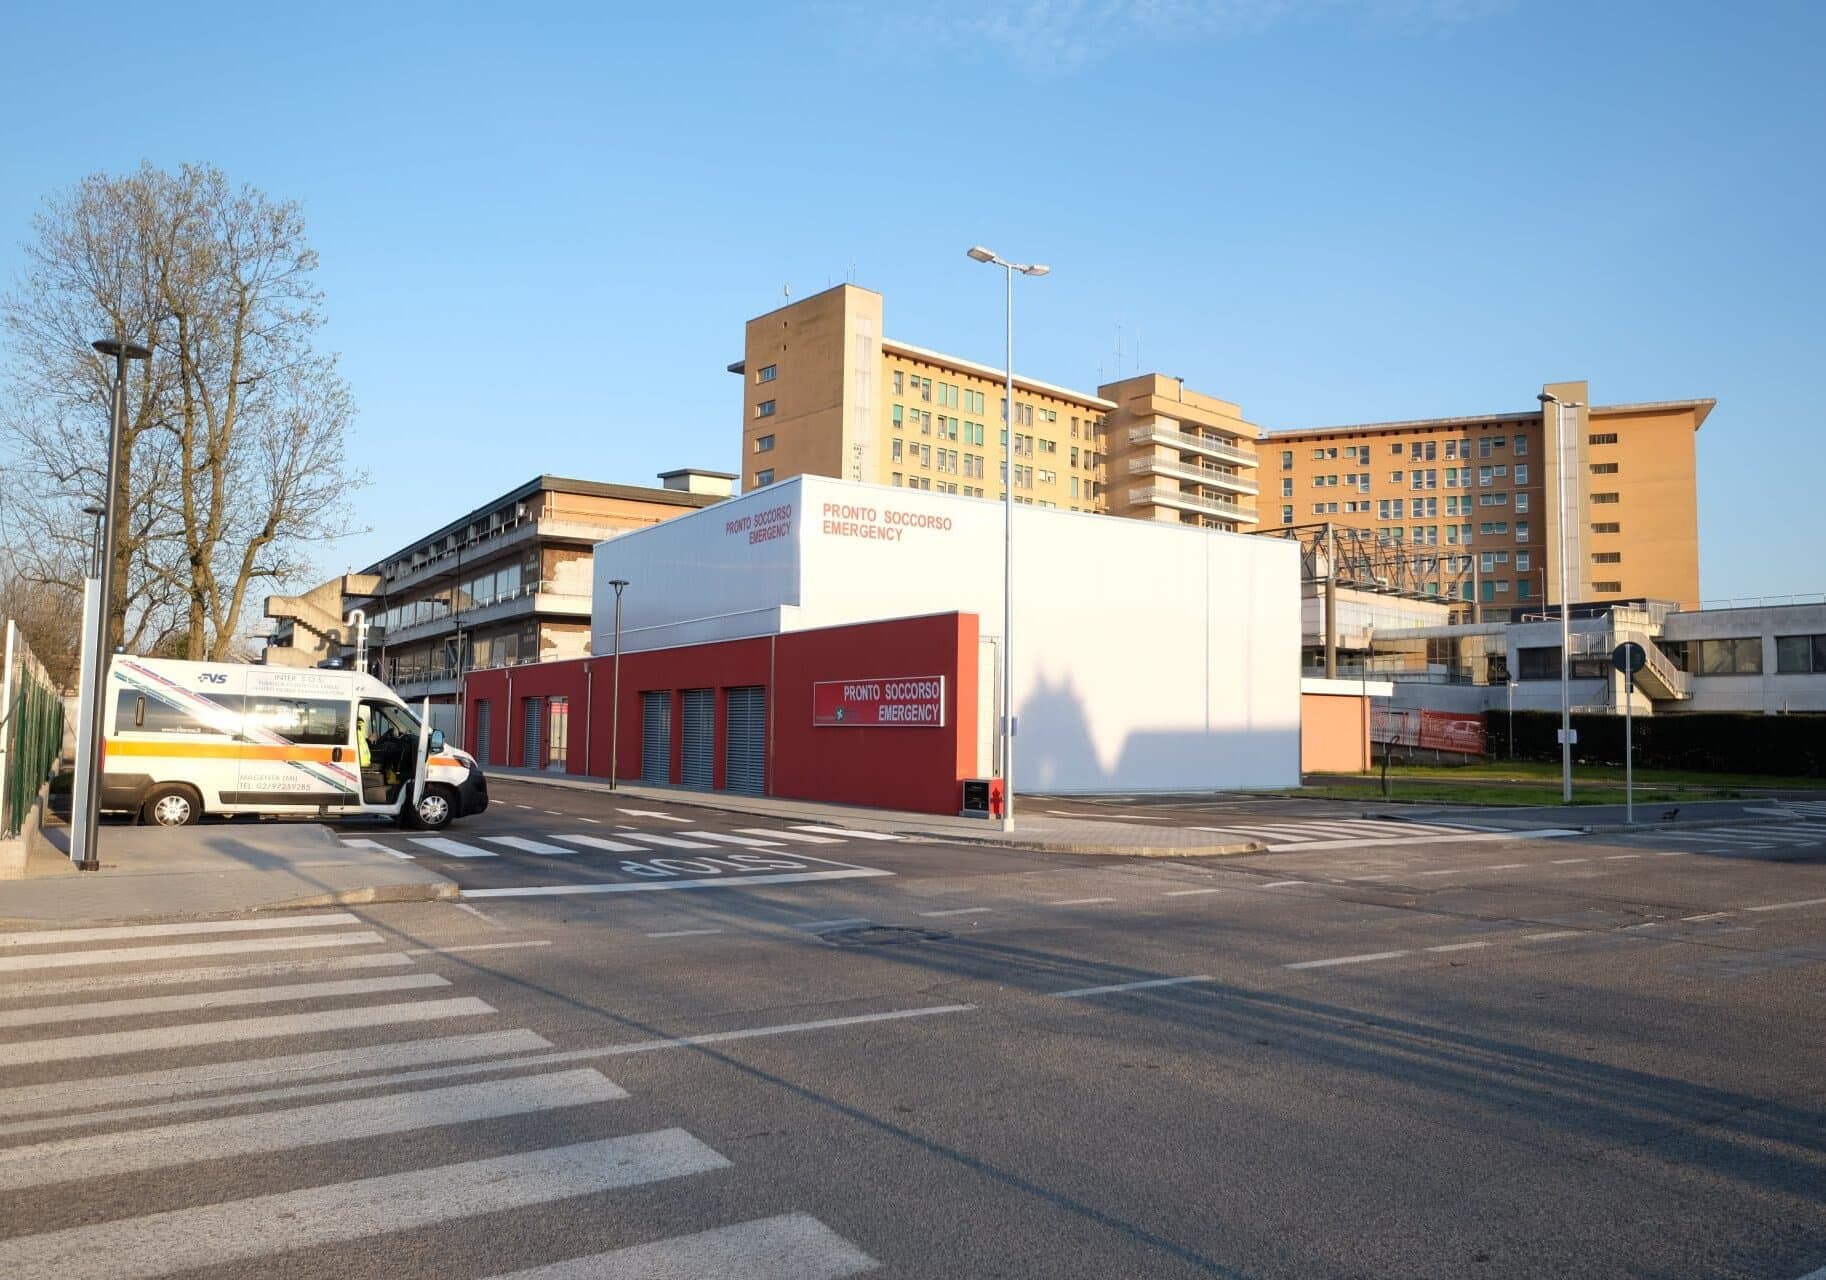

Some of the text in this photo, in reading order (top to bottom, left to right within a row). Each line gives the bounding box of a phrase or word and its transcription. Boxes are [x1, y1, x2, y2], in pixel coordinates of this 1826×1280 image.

[725, 504, 792, 536] PRONTO SOCCORSO
[823, 503, 952, 531] PRONTO SOCCORSO
[749, 520, 792, 545] EMERGENCY
[823, 520, 903, 541] EMERGENCY
[844, 681, 940, 702] PRONTO SOCCORSO
[878, 703, 939, 721] EMERGENCY
[619, 854, 807, 877] STOP
